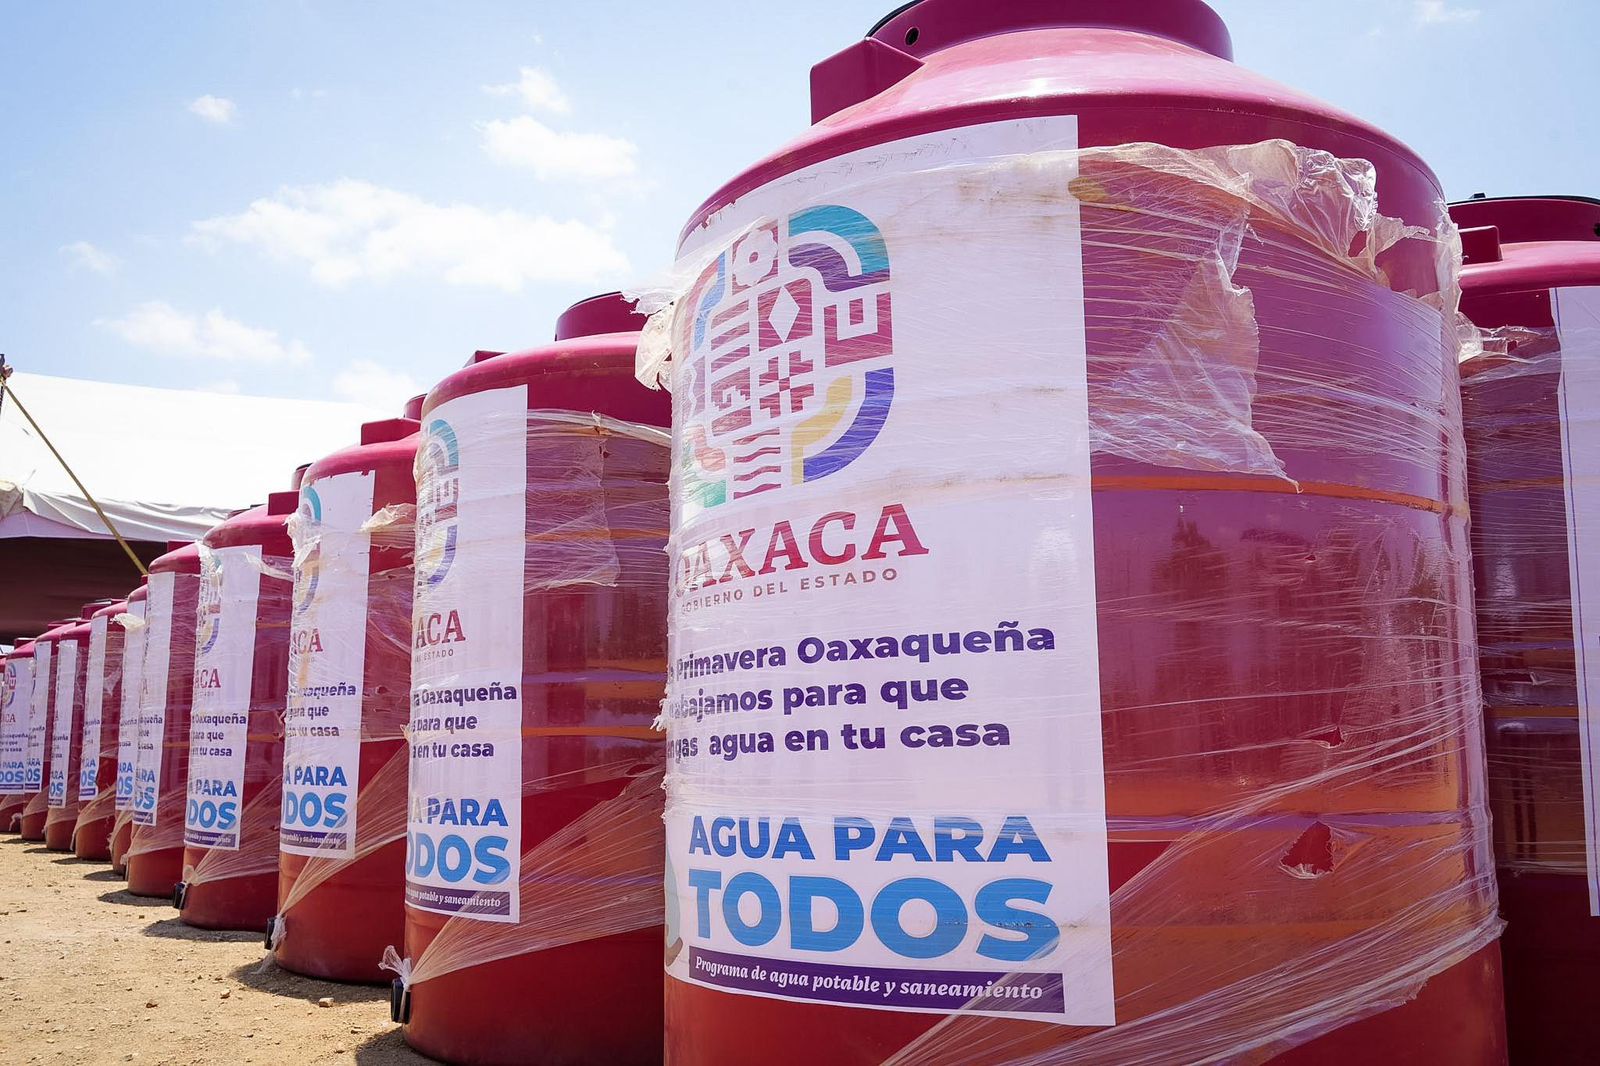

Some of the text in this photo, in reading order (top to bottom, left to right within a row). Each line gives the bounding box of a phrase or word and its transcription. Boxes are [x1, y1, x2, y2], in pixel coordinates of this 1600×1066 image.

[753, 581, 788, 598] DEL
[801, 568, 898, 591] ESTADO
[677, 621, 1055, 681] Primavera Oaxaqueña
[422, 682, 517, 706] Oaxaqueña
[783, 682, 866, 715] para
[880, 677, 969, 709] que
[307, 706, 330, 720] que
[445, 715, 478, 735] que
[207, 732, 224, 742] que
[310, 726, 340, 737] casa
[709, 732, 774, 761] agua
[785, 730, 828, 751] en
[841, 722, 886, 750] tu
[900, 722, 1010, 748] casa
[209, 748, 232, 757] casa
[433, 742, 446, 758] tu
[451, 742, 494, 758] casa
[295, 765, 348, 787] PARA
[427, 798, 508, 827] PARA
[689, 815, 1053, 862] AGUA PARA
[689, 868, 1059, 961] TODOS
[695, 956, 1043, 999] Programa de agua potable y saneamiento
